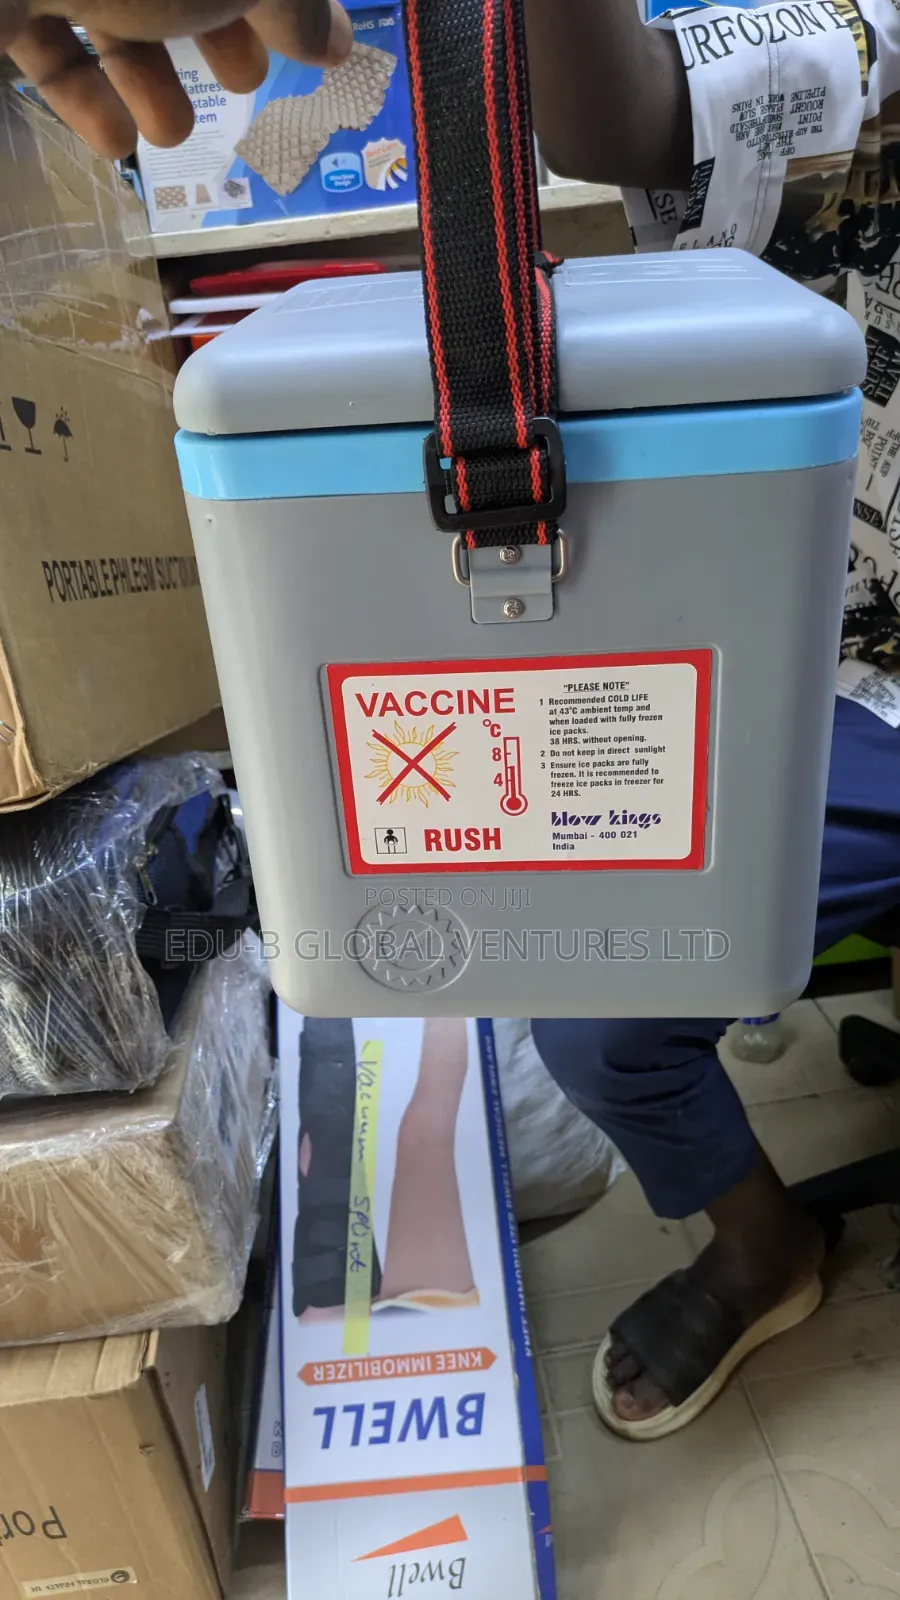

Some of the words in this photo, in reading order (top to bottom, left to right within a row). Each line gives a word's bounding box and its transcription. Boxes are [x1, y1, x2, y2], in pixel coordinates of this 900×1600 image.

[353, 20, 375, 31] RoHS
[791, 87, 826, 102] PIPELINE
[192, 95, 227, 109] stable
[732, 99, 753, 113] PAIRS
[798, 112, 823, 124] POINT
[41, 559, 112, 603] PORTABLE
[355, 688, 515, 717] VACCINE
[549, 696, 605, 705] Recommended
[608, 694, 629, 702] COLD
[631, 693, 649, 701] LIFE
[580, 705, 611, 714] ambient
[614, 705, 633, 714] temp
[572, 716, 598, 724] loaded
[600, 715, 617, 723] with
[619, 714, 636, 723] fully
[563, 726, 589, 736] packs.
[582, 735, 611, 744] without
[613, 734, 647, 743] opening.
[491, 747, 502, 762] 8
[577, 748, 595, 757] keep
[597, 747, 605, 755] in
[607, 746, 630, 755] direct
[634, 746, 666, 754] sunlight
[550, 761, 576, 769] Ensure
[592, 760, 615, 769] packs
[632, 758, 649, 767] fully
[595, 768, 649, 776] recommended
[493, 773, 503, 787] 4
[590, 779, 612, 788] packs
[563, 789, 581, 797] HRS.
[551, 811, 602, 826] blow
[609, 809, 662, 829] kings
[424, 827, 502, 852] RUSH
[552, 831, 588, 840] Mumbai
[599, 831, 616, 839] 400
[620, 830, 637, 838] 021
[437, 1351, 483, 1365] KNEE
[313, 1355, 431, 1381] IMMOBILIZER
[313, 1392, 486, 1450] BWELL
[0, 1505, 67, 1546] Por
[387, 1557, 467, 1599] Bwell
